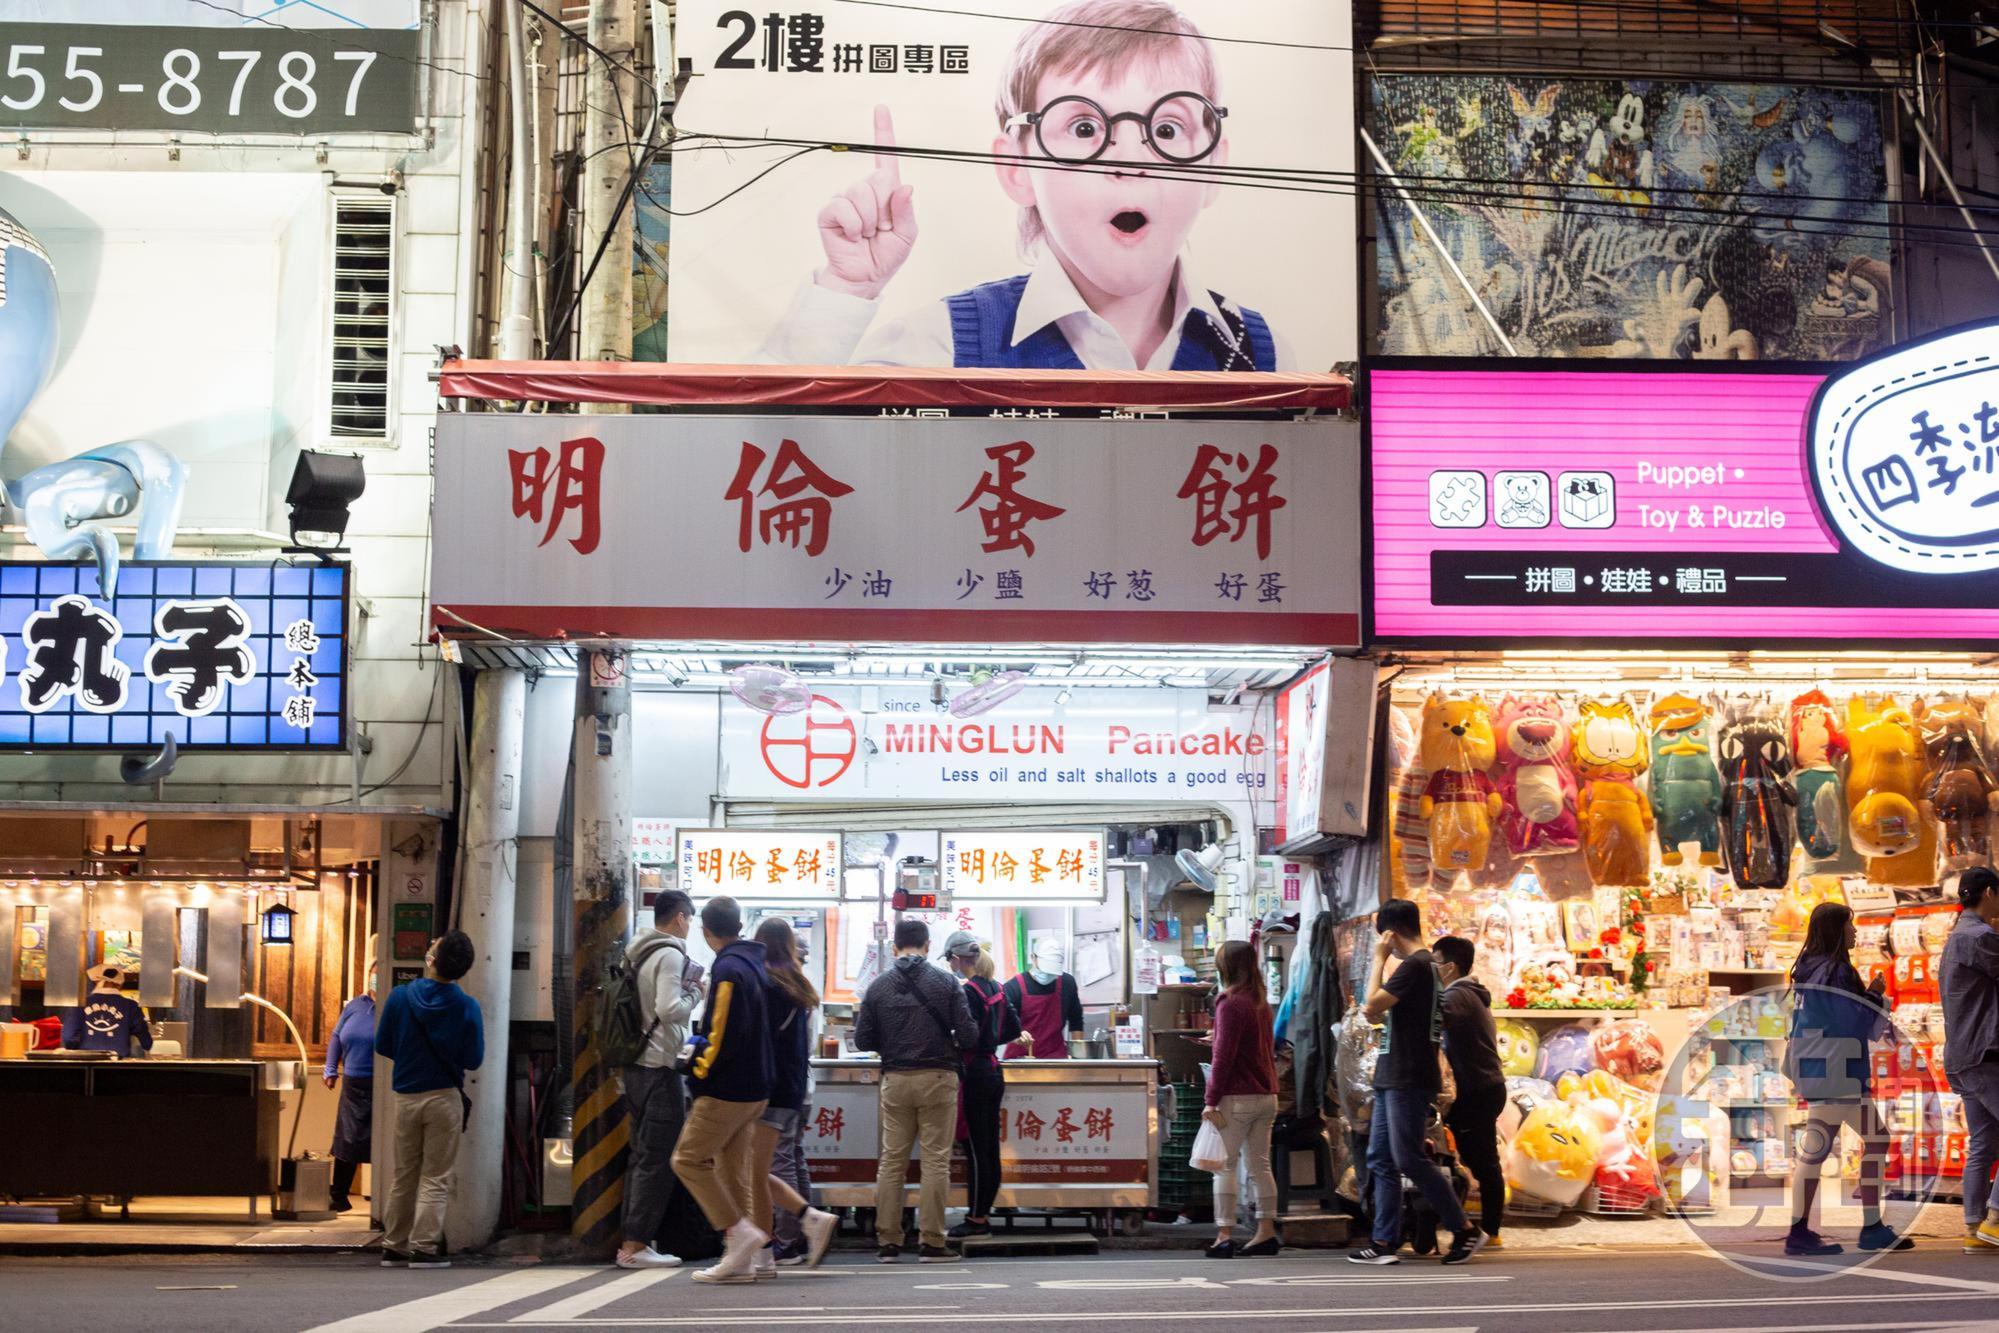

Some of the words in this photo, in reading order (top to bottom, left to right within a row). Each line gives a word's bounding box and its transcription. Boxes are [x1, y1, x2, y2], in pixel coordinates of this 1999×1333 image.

[713, 10, 825, 73] 2樓
[833, 43, 970, 74] 拼圖專區
[0, 45, 378, 119] 55-8787
[1637, 461, 1726, 489] Puppet
[507, 436, 1288, 561] 明倫蛋餅
[1638, 504, 1680, 533] Toy
[1687, 506, 1706, 528] &
[1712, 505, 1786, 529] Puzzle
[825, 567, 893, 599] 少油
[956, 569, 1025, 600] 少鹽
[1214, 572, 1288, 604] 好蛋
[884, 699, 921, 713] since
[885, 723, 1064, 754] MINGLUN
[1107, 725, 1265, 756] Pancake
[941, 766, 979, 782] Less
[989, 766, 1009, 782] oil
[1017, 767, 1048, 782] and
[1056, 767, 1086, 783] salt
[1095, 768, 1158, 784] shallots
[1167, 771, 1177, 783] a
[1186, 769, 1227, 788] good
[1236, 772, 1266, 788] egg
[696, 847, 823, 885] 明倫蛋餅
[959, 847, 1085, 885] 明倫蛋餅
